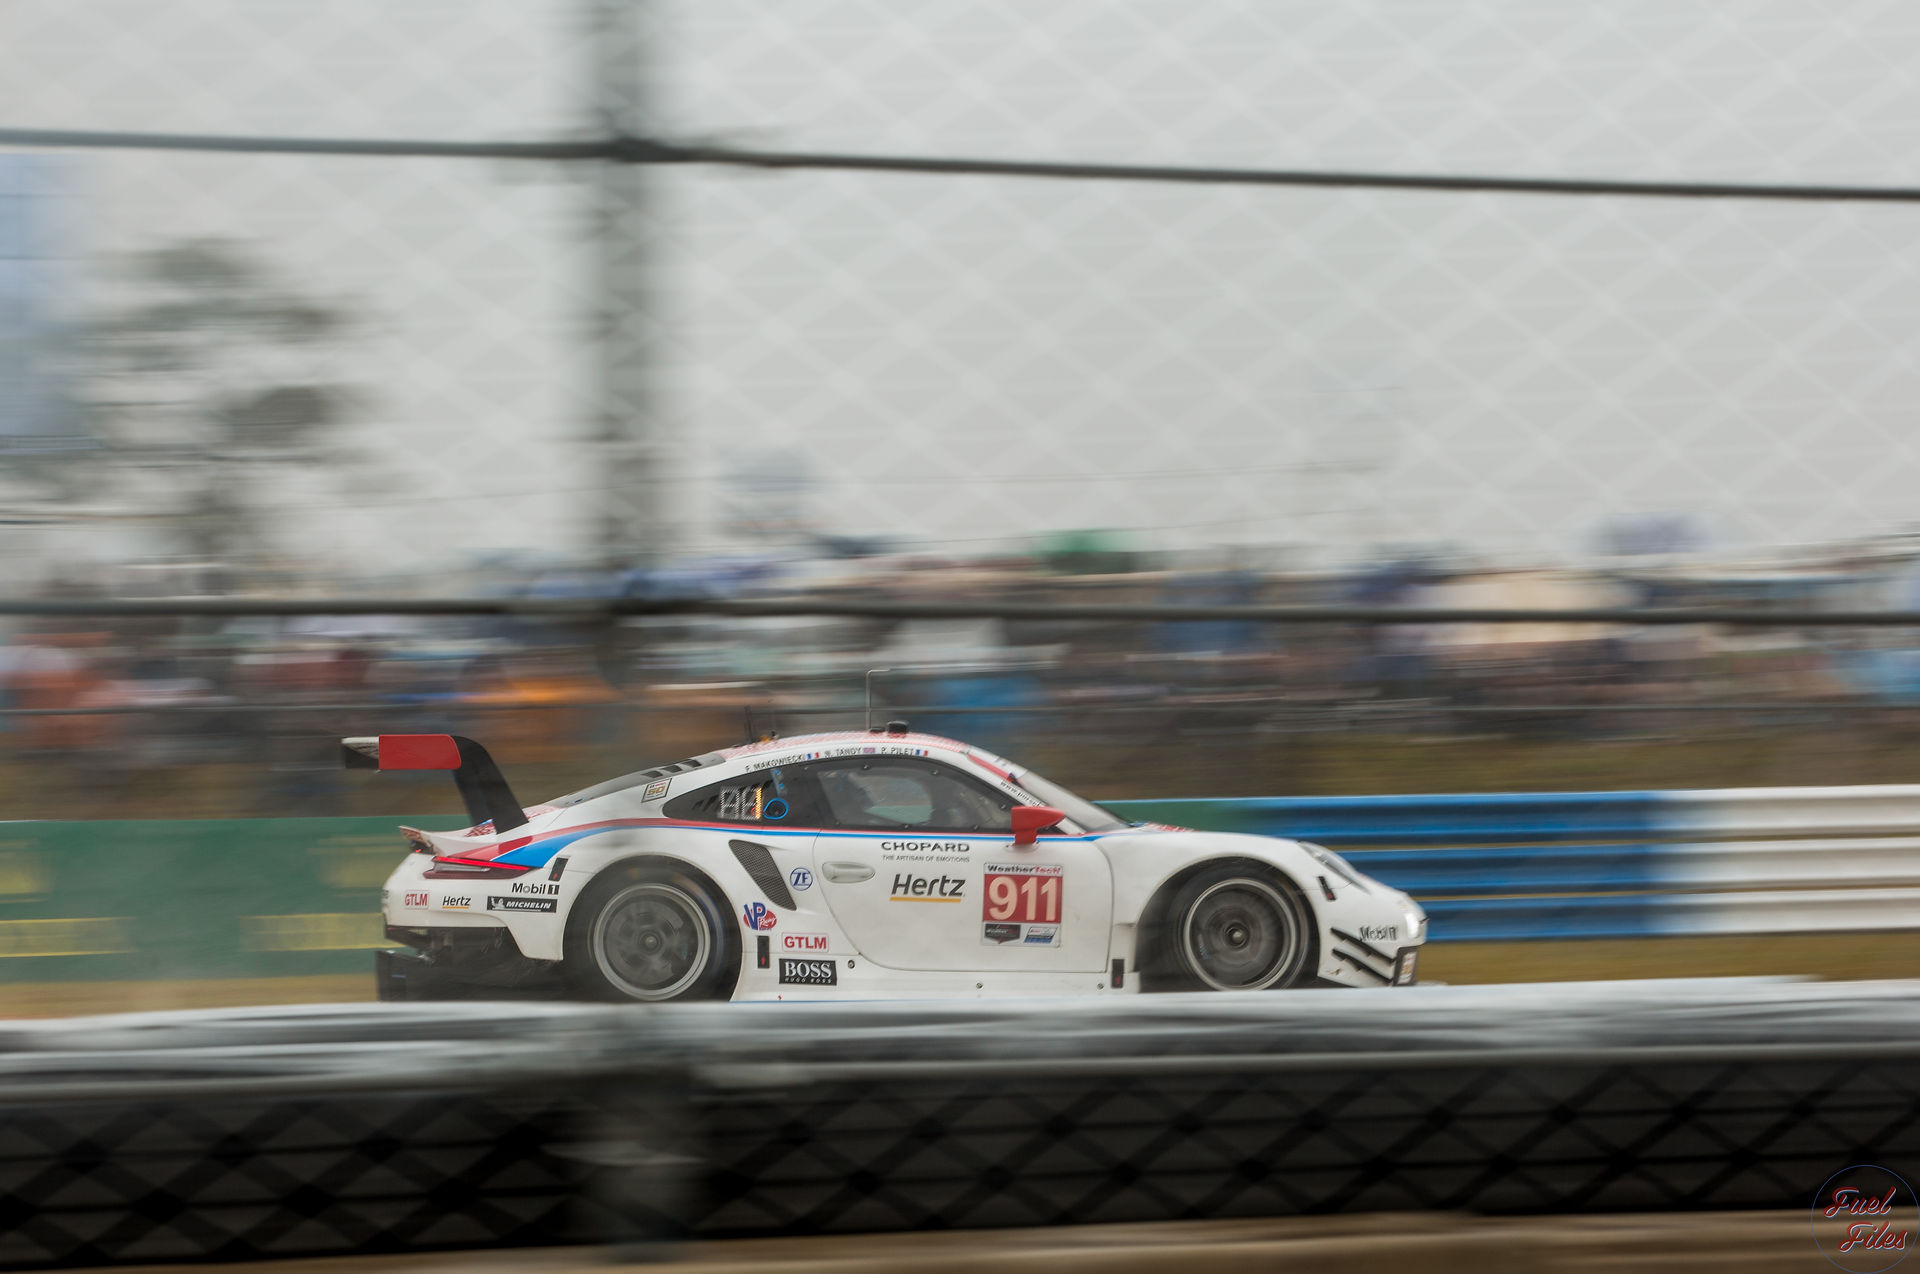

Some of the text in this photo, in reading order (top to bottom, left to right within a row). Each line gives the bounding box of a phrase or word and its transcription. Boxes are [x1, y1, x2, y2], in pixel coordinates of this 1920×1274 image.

[881, 841, 970, 852] CHOPARD
[793, 872, 809, 886] ZF
[891, 873, 966, 897] Hertz
[511, 882, 560, 895] Mobil 1
[404, 893, 428, 906] GTLM
[442, 895, 471, 906] Hertz
[988, 875, 1058, 921] 911
[506, 901, 552, 909] MICHELIN
[743, 901, 767, 930] VP
[784, 936, 827, 949] GTLM
[784, 961, 832, 978] BOSS
